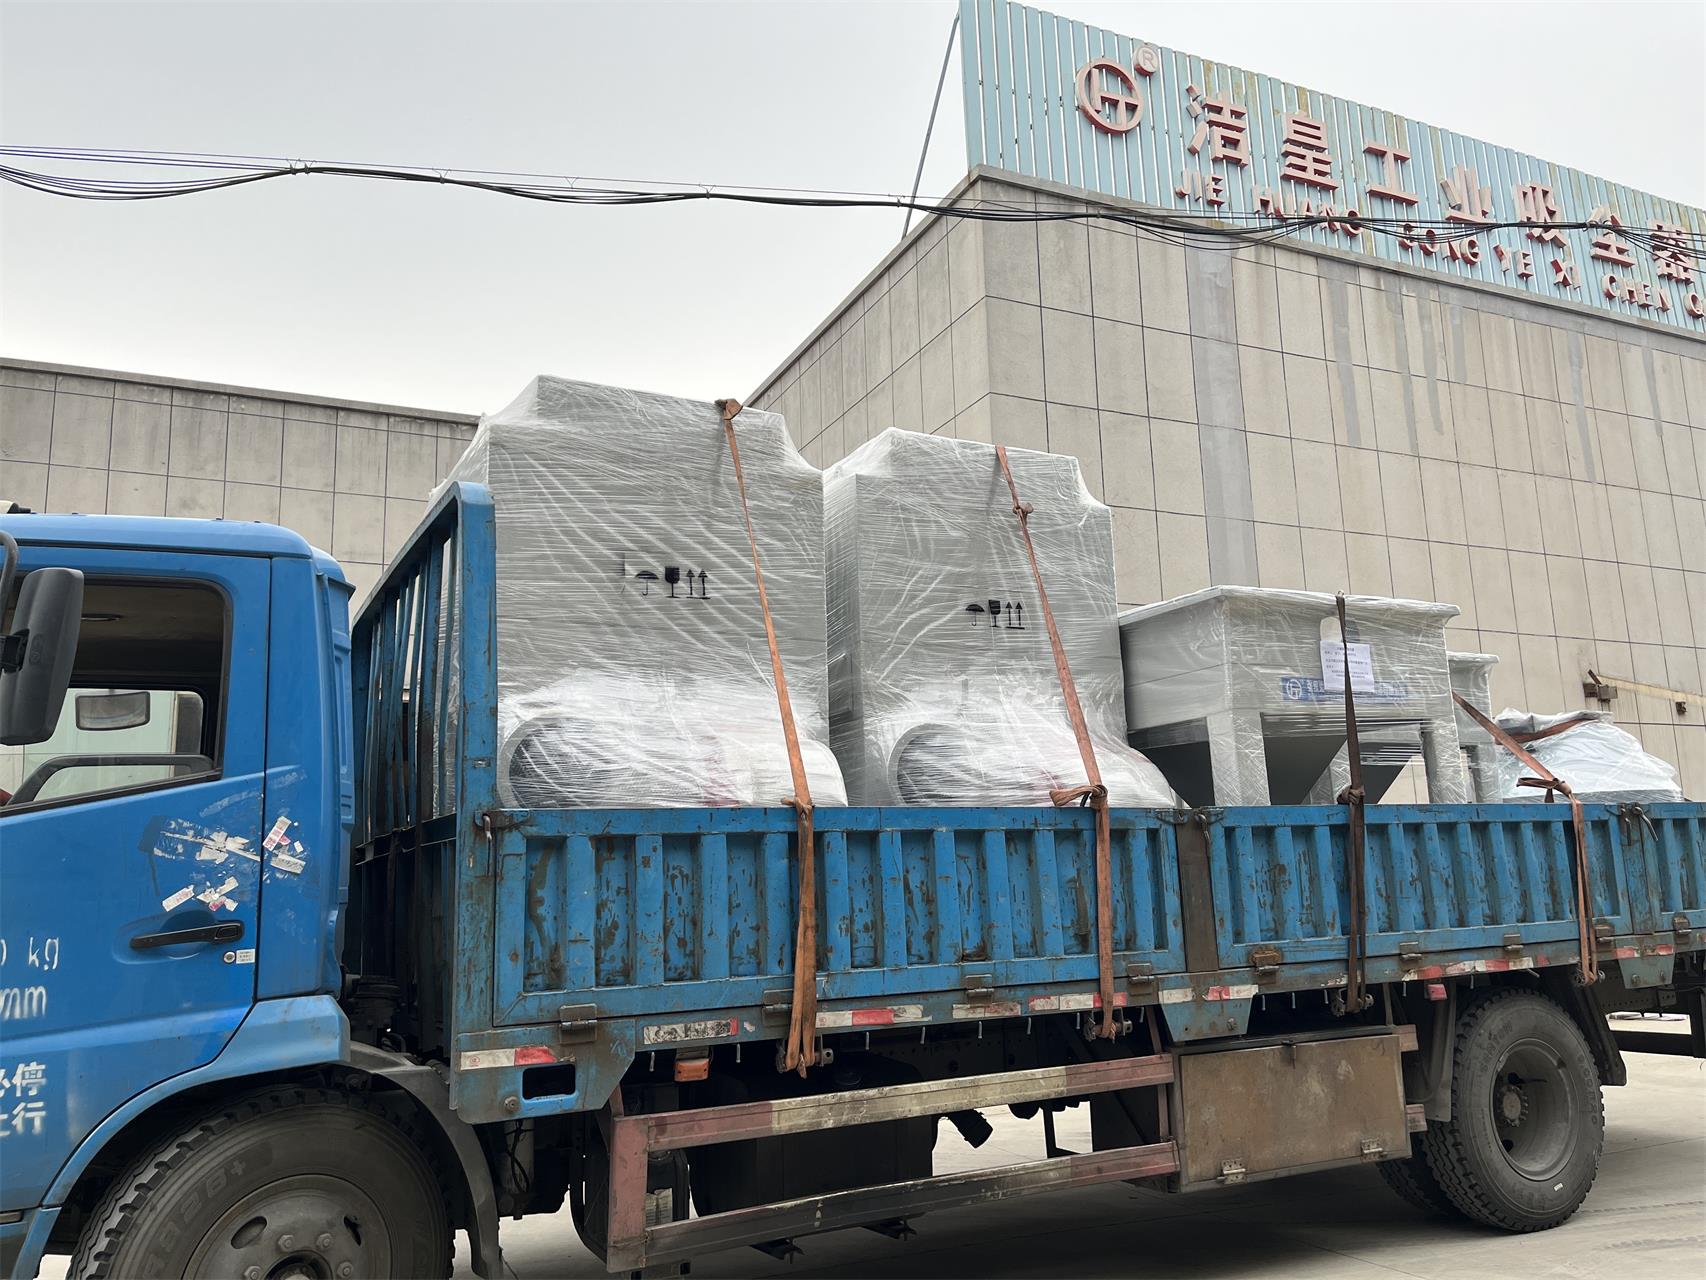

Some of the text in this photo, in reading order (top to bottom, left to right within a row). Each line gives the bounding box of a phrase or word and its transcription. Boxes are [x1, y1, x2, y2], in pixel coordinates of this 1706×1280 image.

[1175, 170, 1226, 206] JIE
[1493, 243, 1534, 279] YE
[1550, 258, 1582, 289] XI
[1602, 273, 1672, 313] CHEN
[1684, 291, 1706, 319] Q
[28, 936, 60, 971] kg
